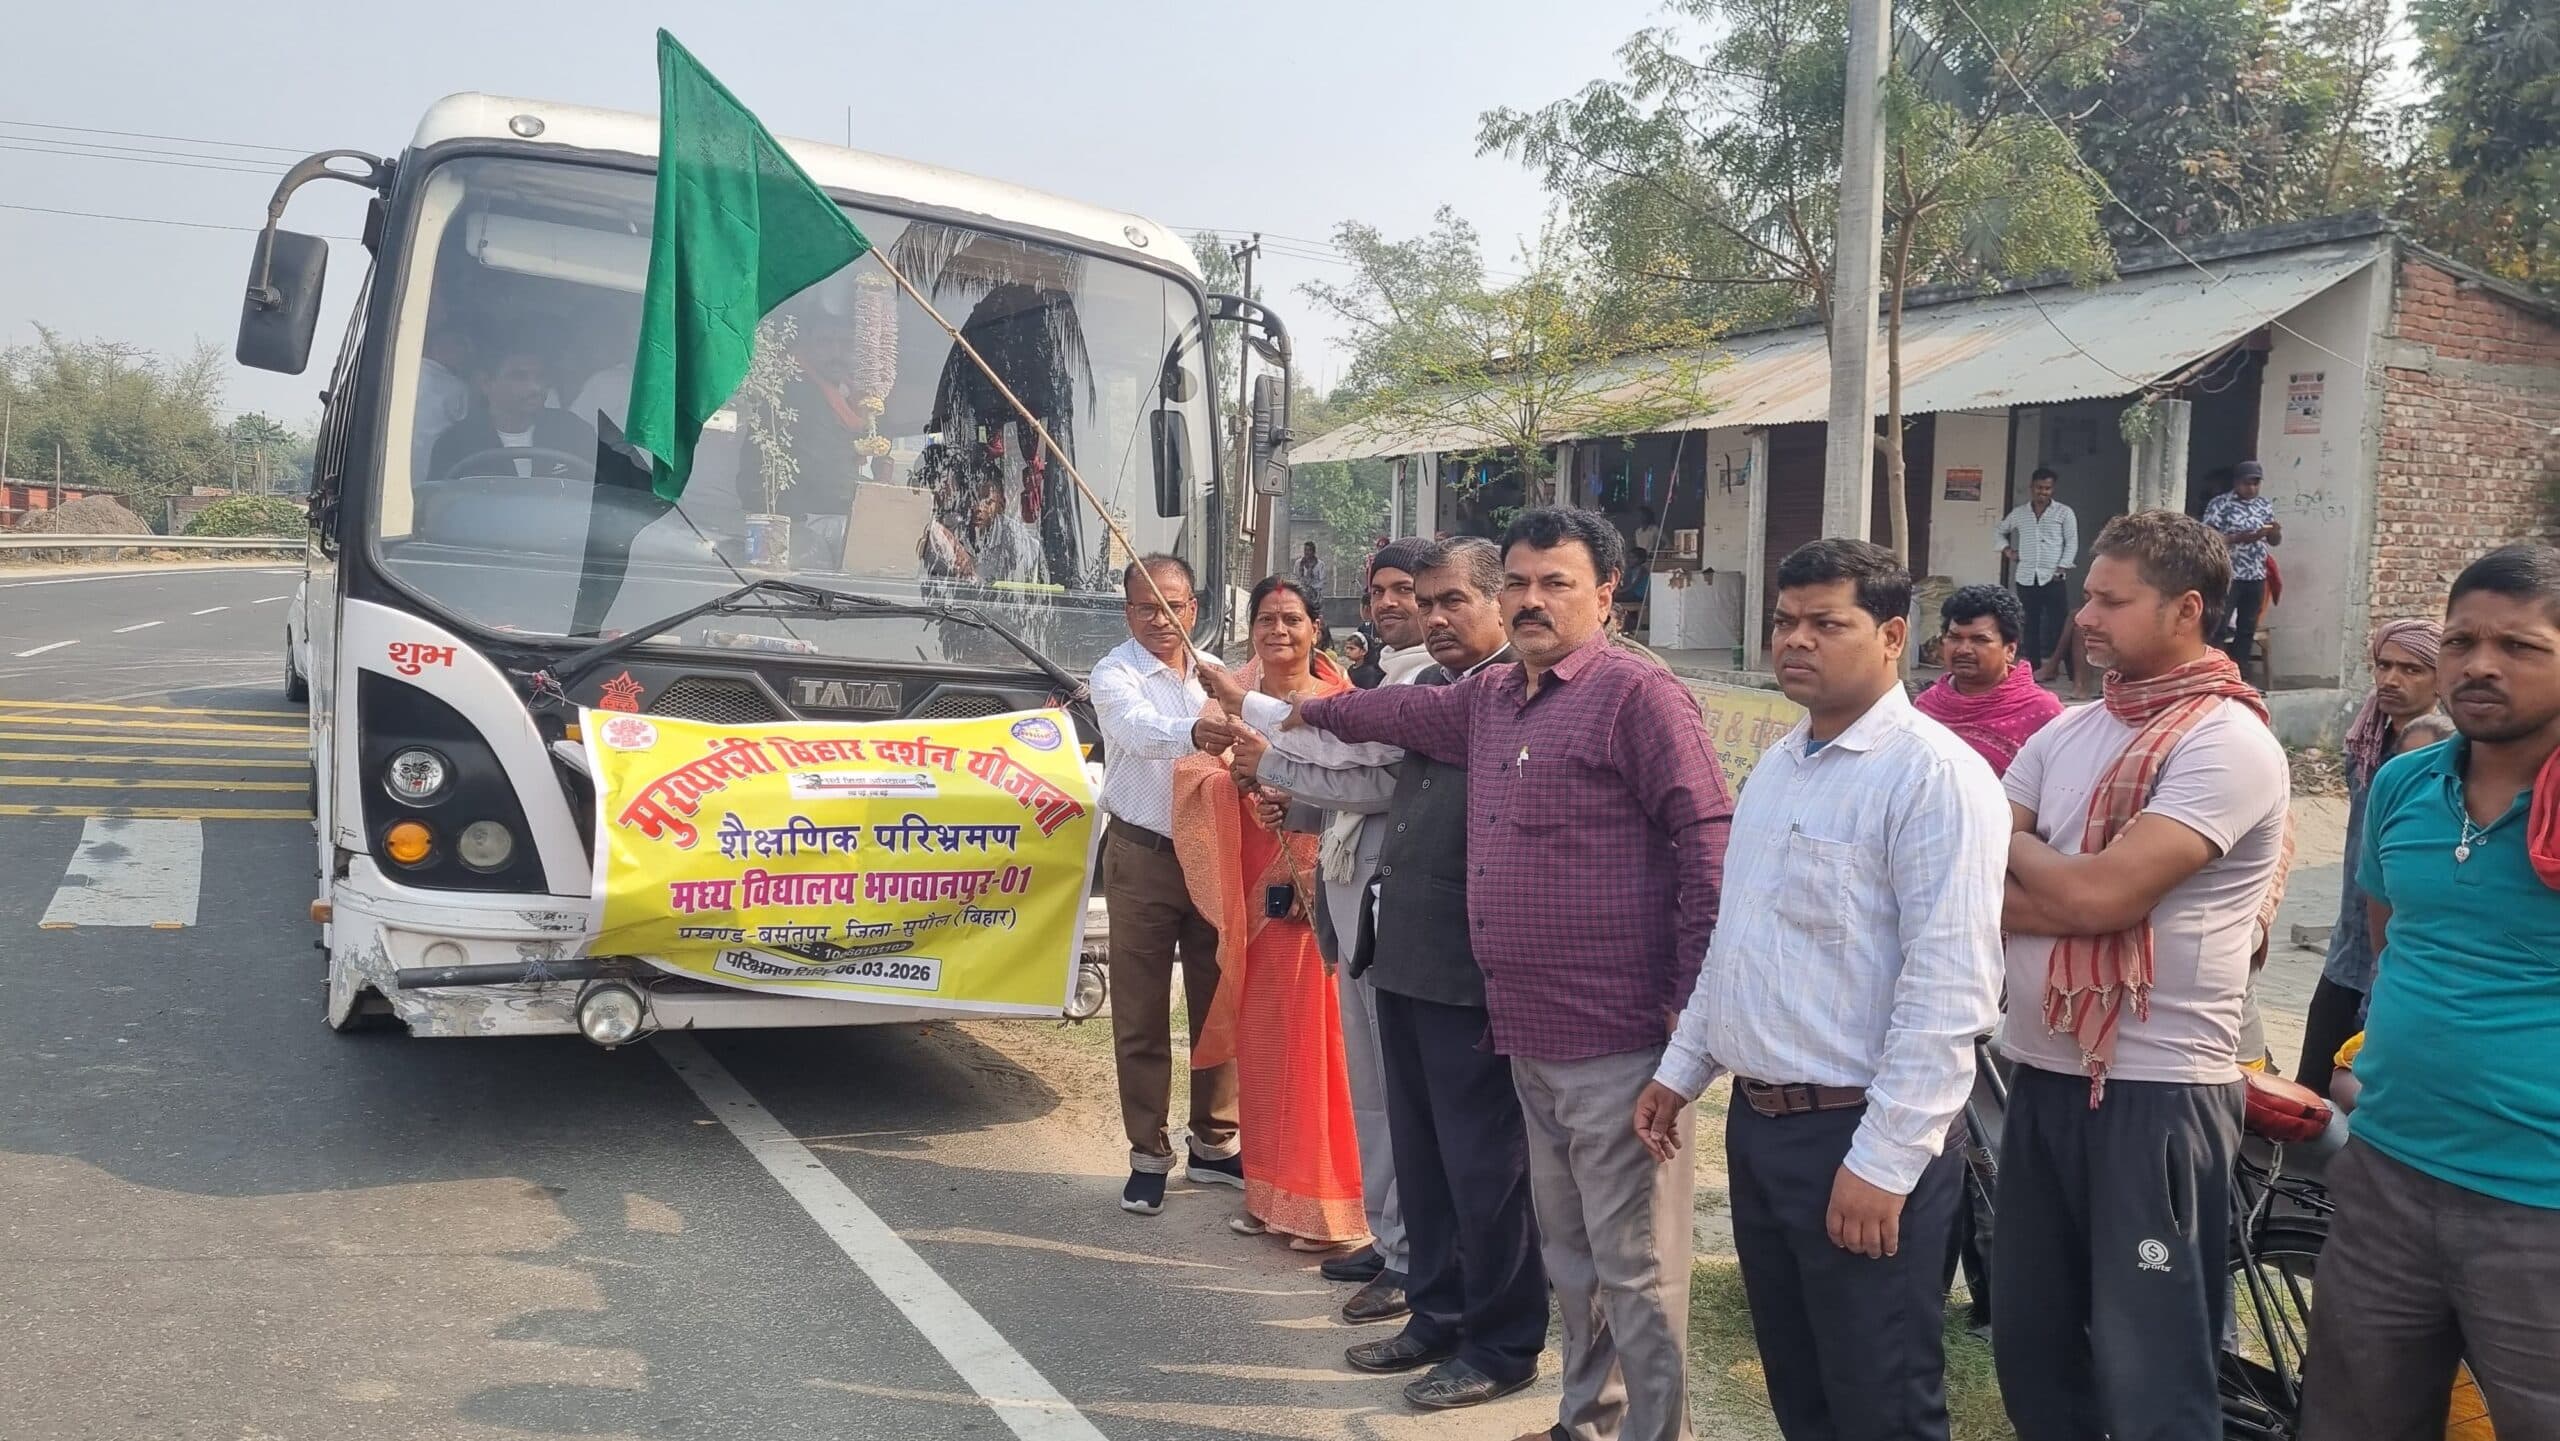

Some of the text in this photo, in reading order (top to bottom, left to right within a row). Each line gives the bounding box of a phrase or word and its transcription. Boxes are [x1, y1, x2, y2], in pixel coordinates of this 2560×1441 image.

[388, 641, 457, 676] शुभ
[798, 680, 894, 709] TATA
[617, 736, 778, 849] मुख्यमंत्री
[764, 736, 866, 769] बिहार
[869, 736, 961, 772] दर्शन
[967, 746, 1086, 838] योजना
[717, 812, 1021, 860] शैक्षणिक परिभ्रमण
[671, 865, 1033, 914] मध्य विद्यालय भगवानपुर-01
[726, 950, 793, 976] परिभ्रमण
[2138, 1262, 2173, 1272] sports
